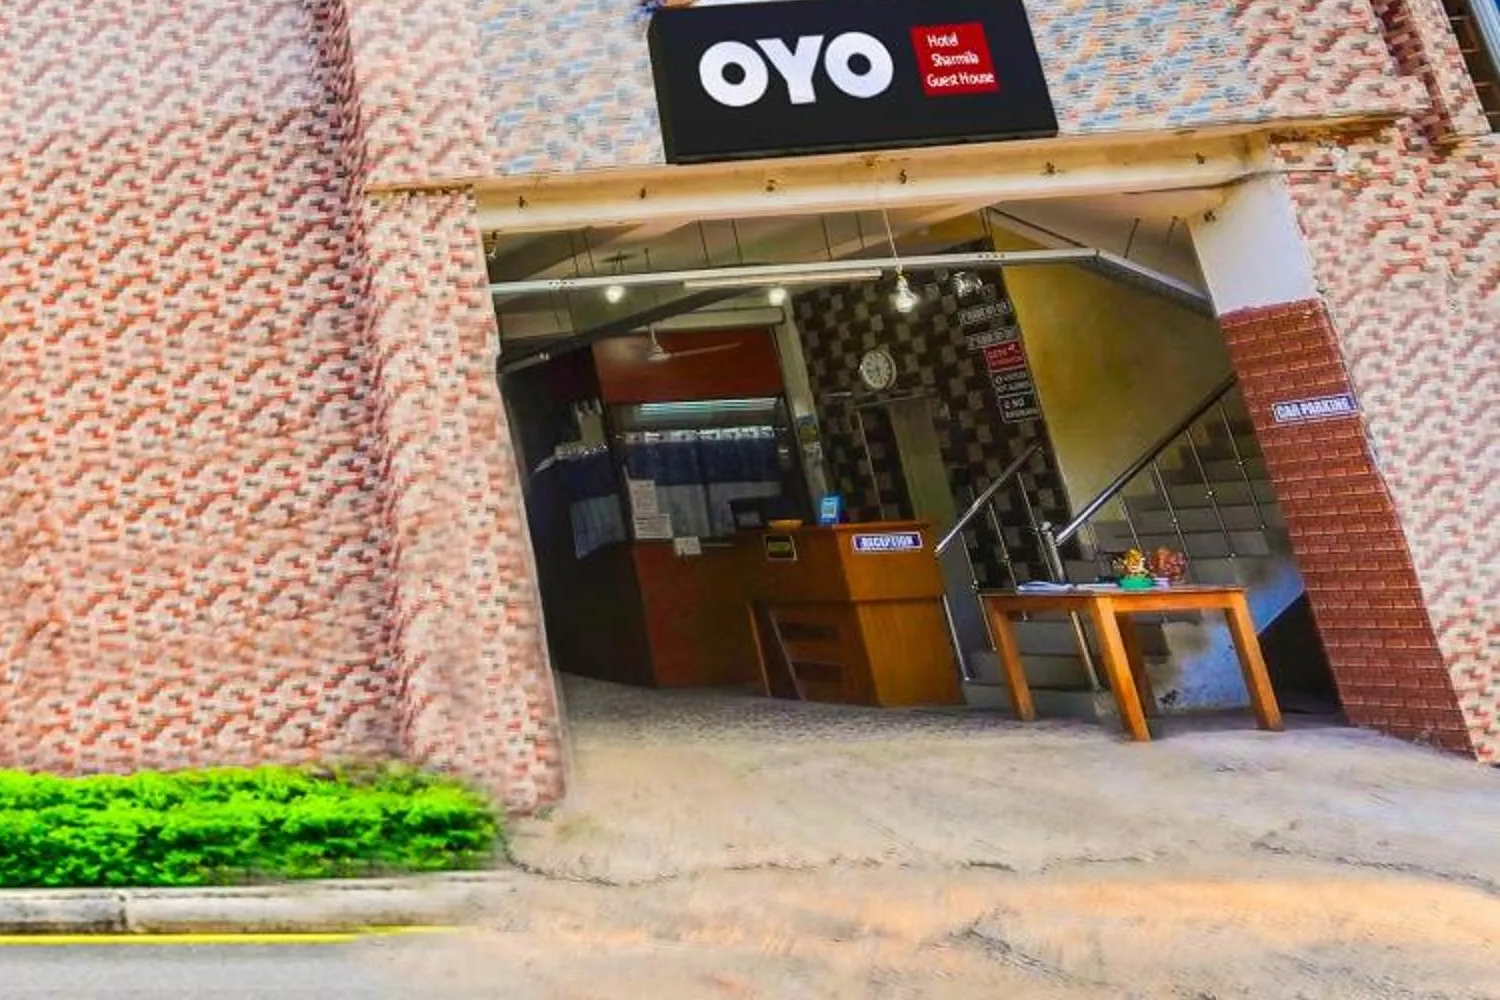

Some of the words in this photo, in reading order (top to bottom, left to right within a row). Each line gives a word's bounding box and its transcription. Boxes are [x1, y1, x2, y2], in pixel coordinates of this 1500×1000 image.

[927, 32, 959, 47] Hotel
[931, 50, 980, 67] Sharmila
[700, 32, 893, 106] OYO
[926, 74, 959, 87] Guest
[959, 72, 995, 85] House
[1300, 397, 1350, 415] PARKING
[861, 536, 914, 548] RECEPTION
